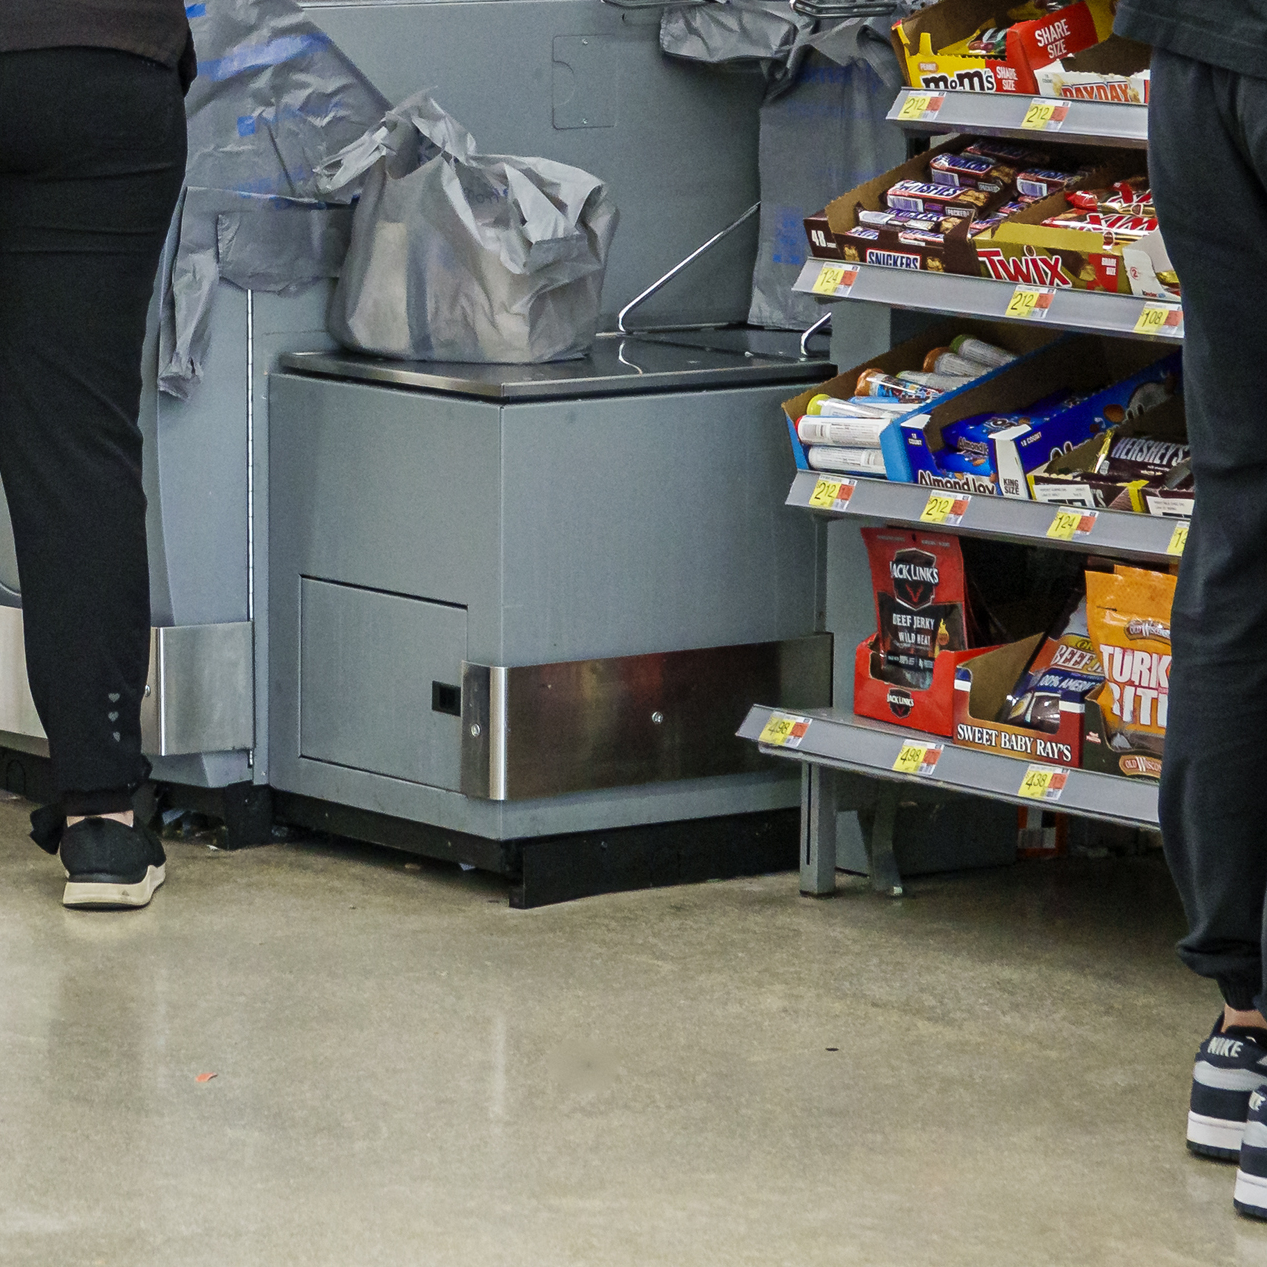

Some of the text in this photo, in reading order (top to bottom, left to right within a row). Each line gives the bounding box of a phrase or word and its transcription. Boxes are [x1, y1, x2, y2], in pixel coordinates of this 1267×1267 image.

[1035, 18, 1071, 47] SHARE
[1047, 39, 1068, 59] SIZE
[996, 66, 1019, 81] SHARE
[1002, 80, 1016, 91] SIZE
[811, 229, 827, 248] 48
[868, 250, 919, 270] SNICKERS
[1111, 436, 1189, 467] HERSHEY'S
[918, 469, 972, 492] Almond
[1003, 478, 1020, 488] KING
[1004, 487, 1020, 496] SIZE
[890, 561, 940, 585] JACK LINK'S
[892, 613, 936, 632] BEEF JERKY
[898, 631, 932, 648] WILD HEAT
[1050, 644, 1091, 671] BEEF
[1099, 643, 1173, 690] TURK
[887, 693, 900, 705] JACK
[1108, 680, 1169, 729] BIT
[957, 723, 999, 747] SWEET
[1000, 729, 1034, 755] BABY
[1036, 737, 1073, 763] RAY'S
[1207, 1035, 1244, 1058] NIKE
